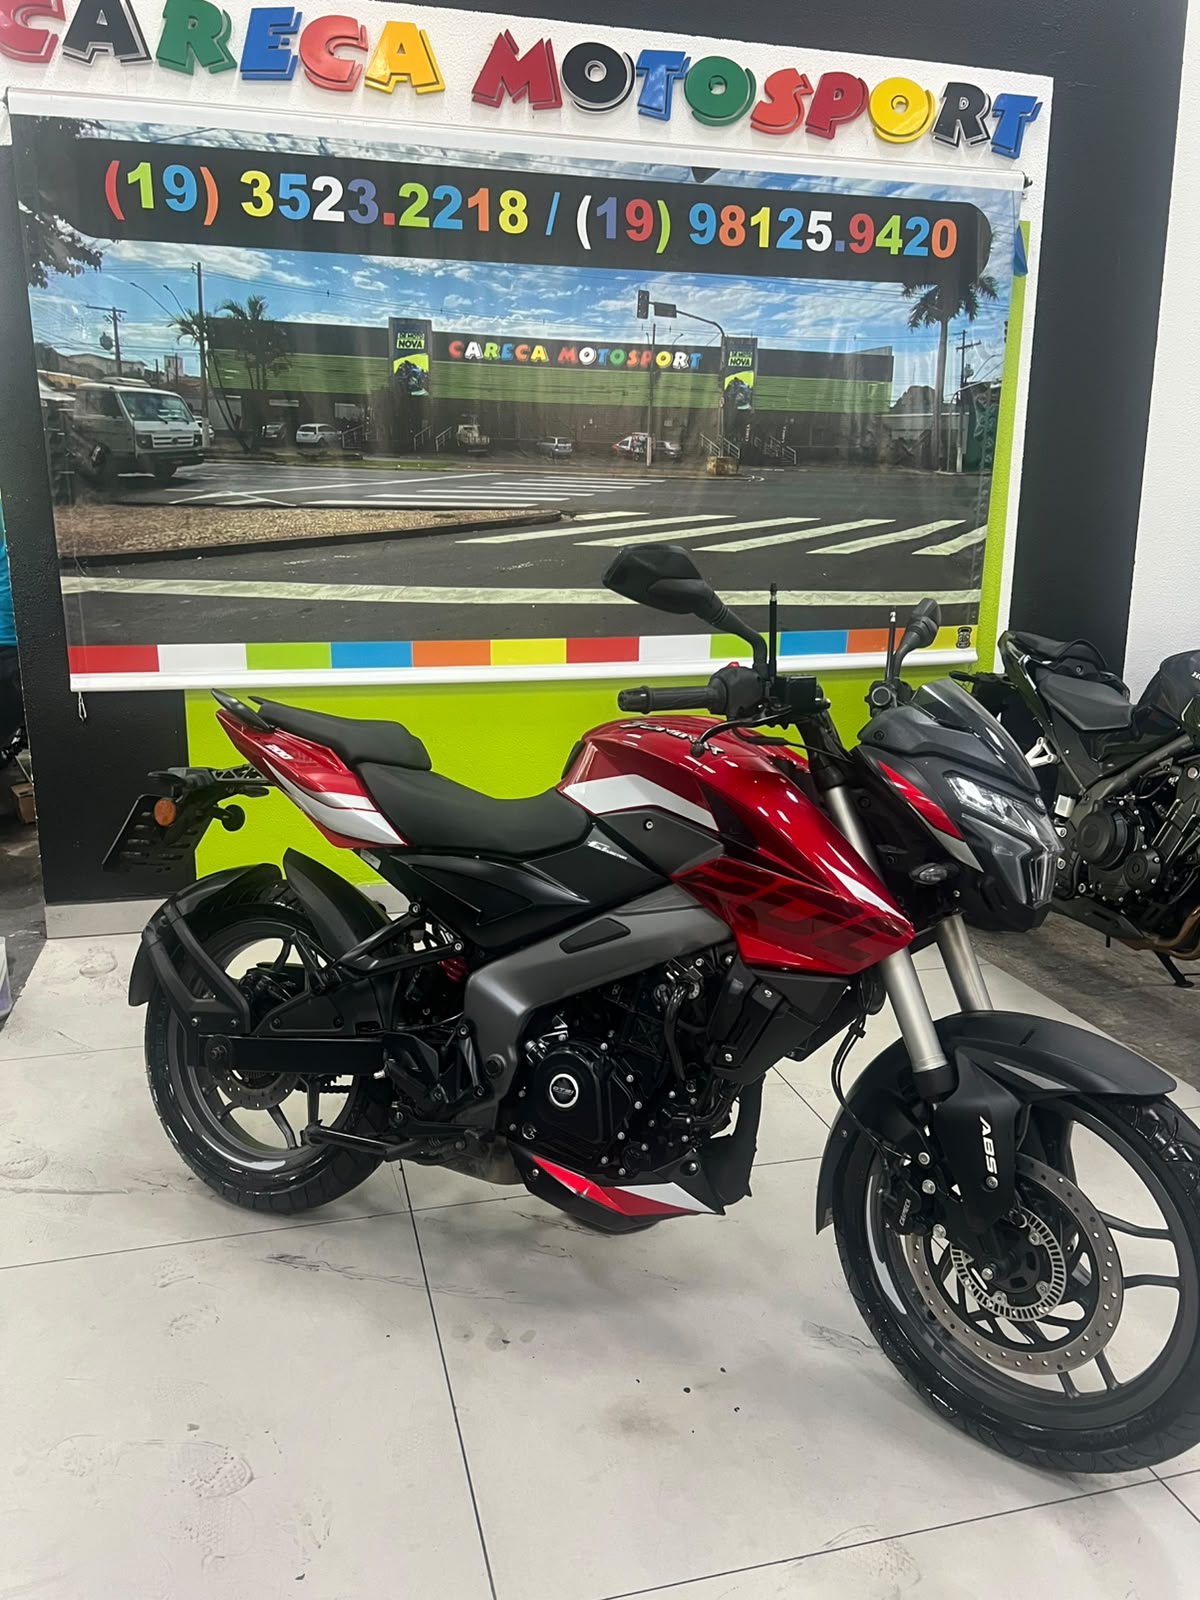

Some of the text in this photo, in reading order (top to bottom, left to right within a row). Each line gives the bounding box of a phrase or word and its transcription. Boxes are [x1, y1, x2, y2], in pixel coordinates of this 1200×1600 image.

[0, 0, 1043, 160] CARECA MOTOSPORT
[105, 160, 220, 226] (19)
[240, 170, 529, 234] 3523.2218
[576, 195, 670, 254] (19)
[689, 202, 957, 259] 98125.9420
[398, 340, 423, 348] NOVA
[449, 340, 703, 370] CARECA MOTOSPORT
[730, 358, 750, 366] NOVA
[979, 1115, 998, 1175] ABS
